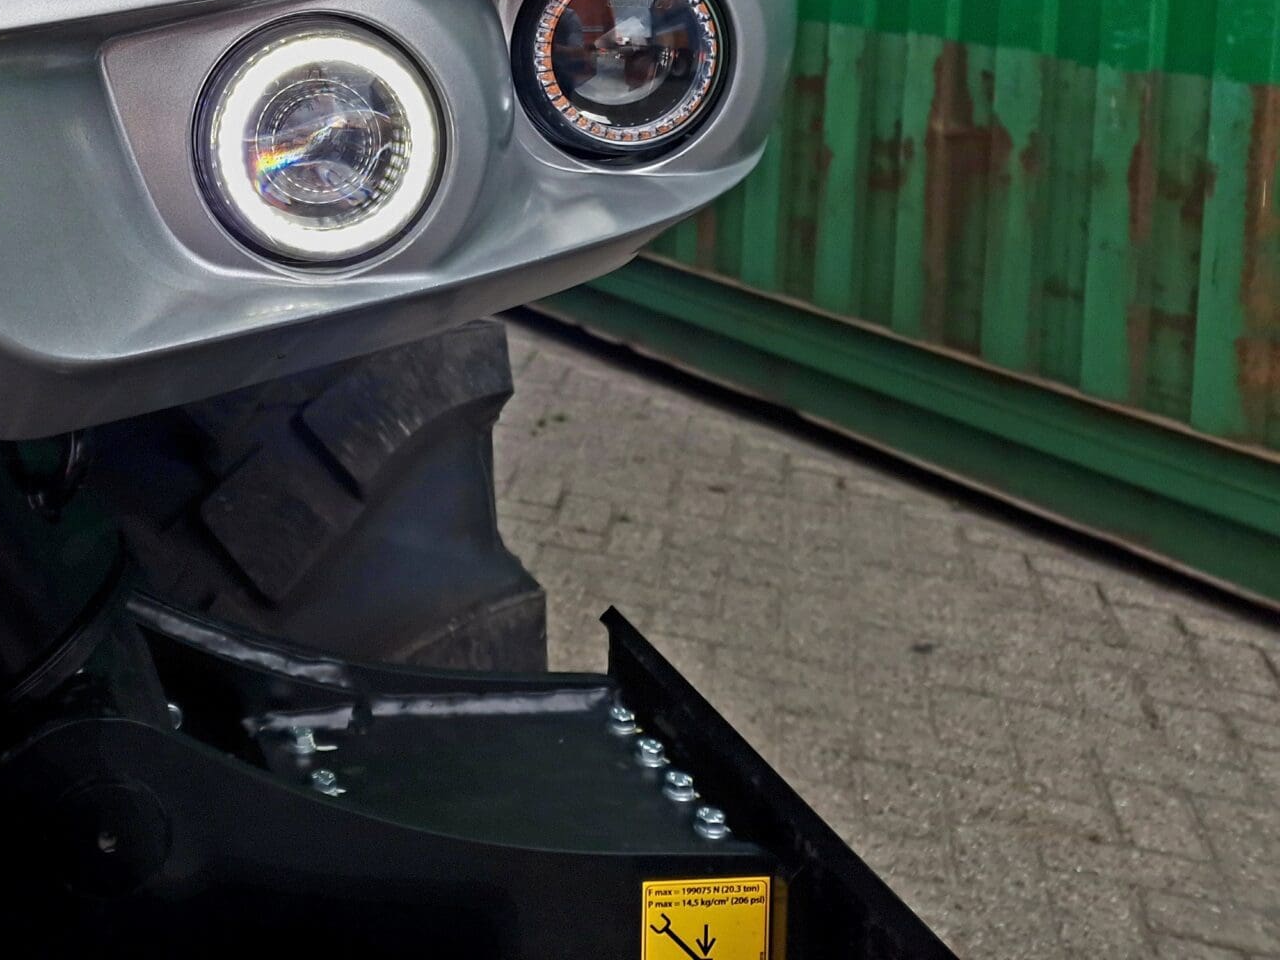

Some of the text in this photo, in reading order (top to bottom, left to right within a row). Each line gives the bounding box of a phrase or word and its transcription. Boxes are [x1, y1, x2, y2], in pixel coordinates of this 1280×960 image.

[682, 887, 712, 895] 199075
[743, 884, 760, 893] ton)
[731, 897, 749, 906] (206
